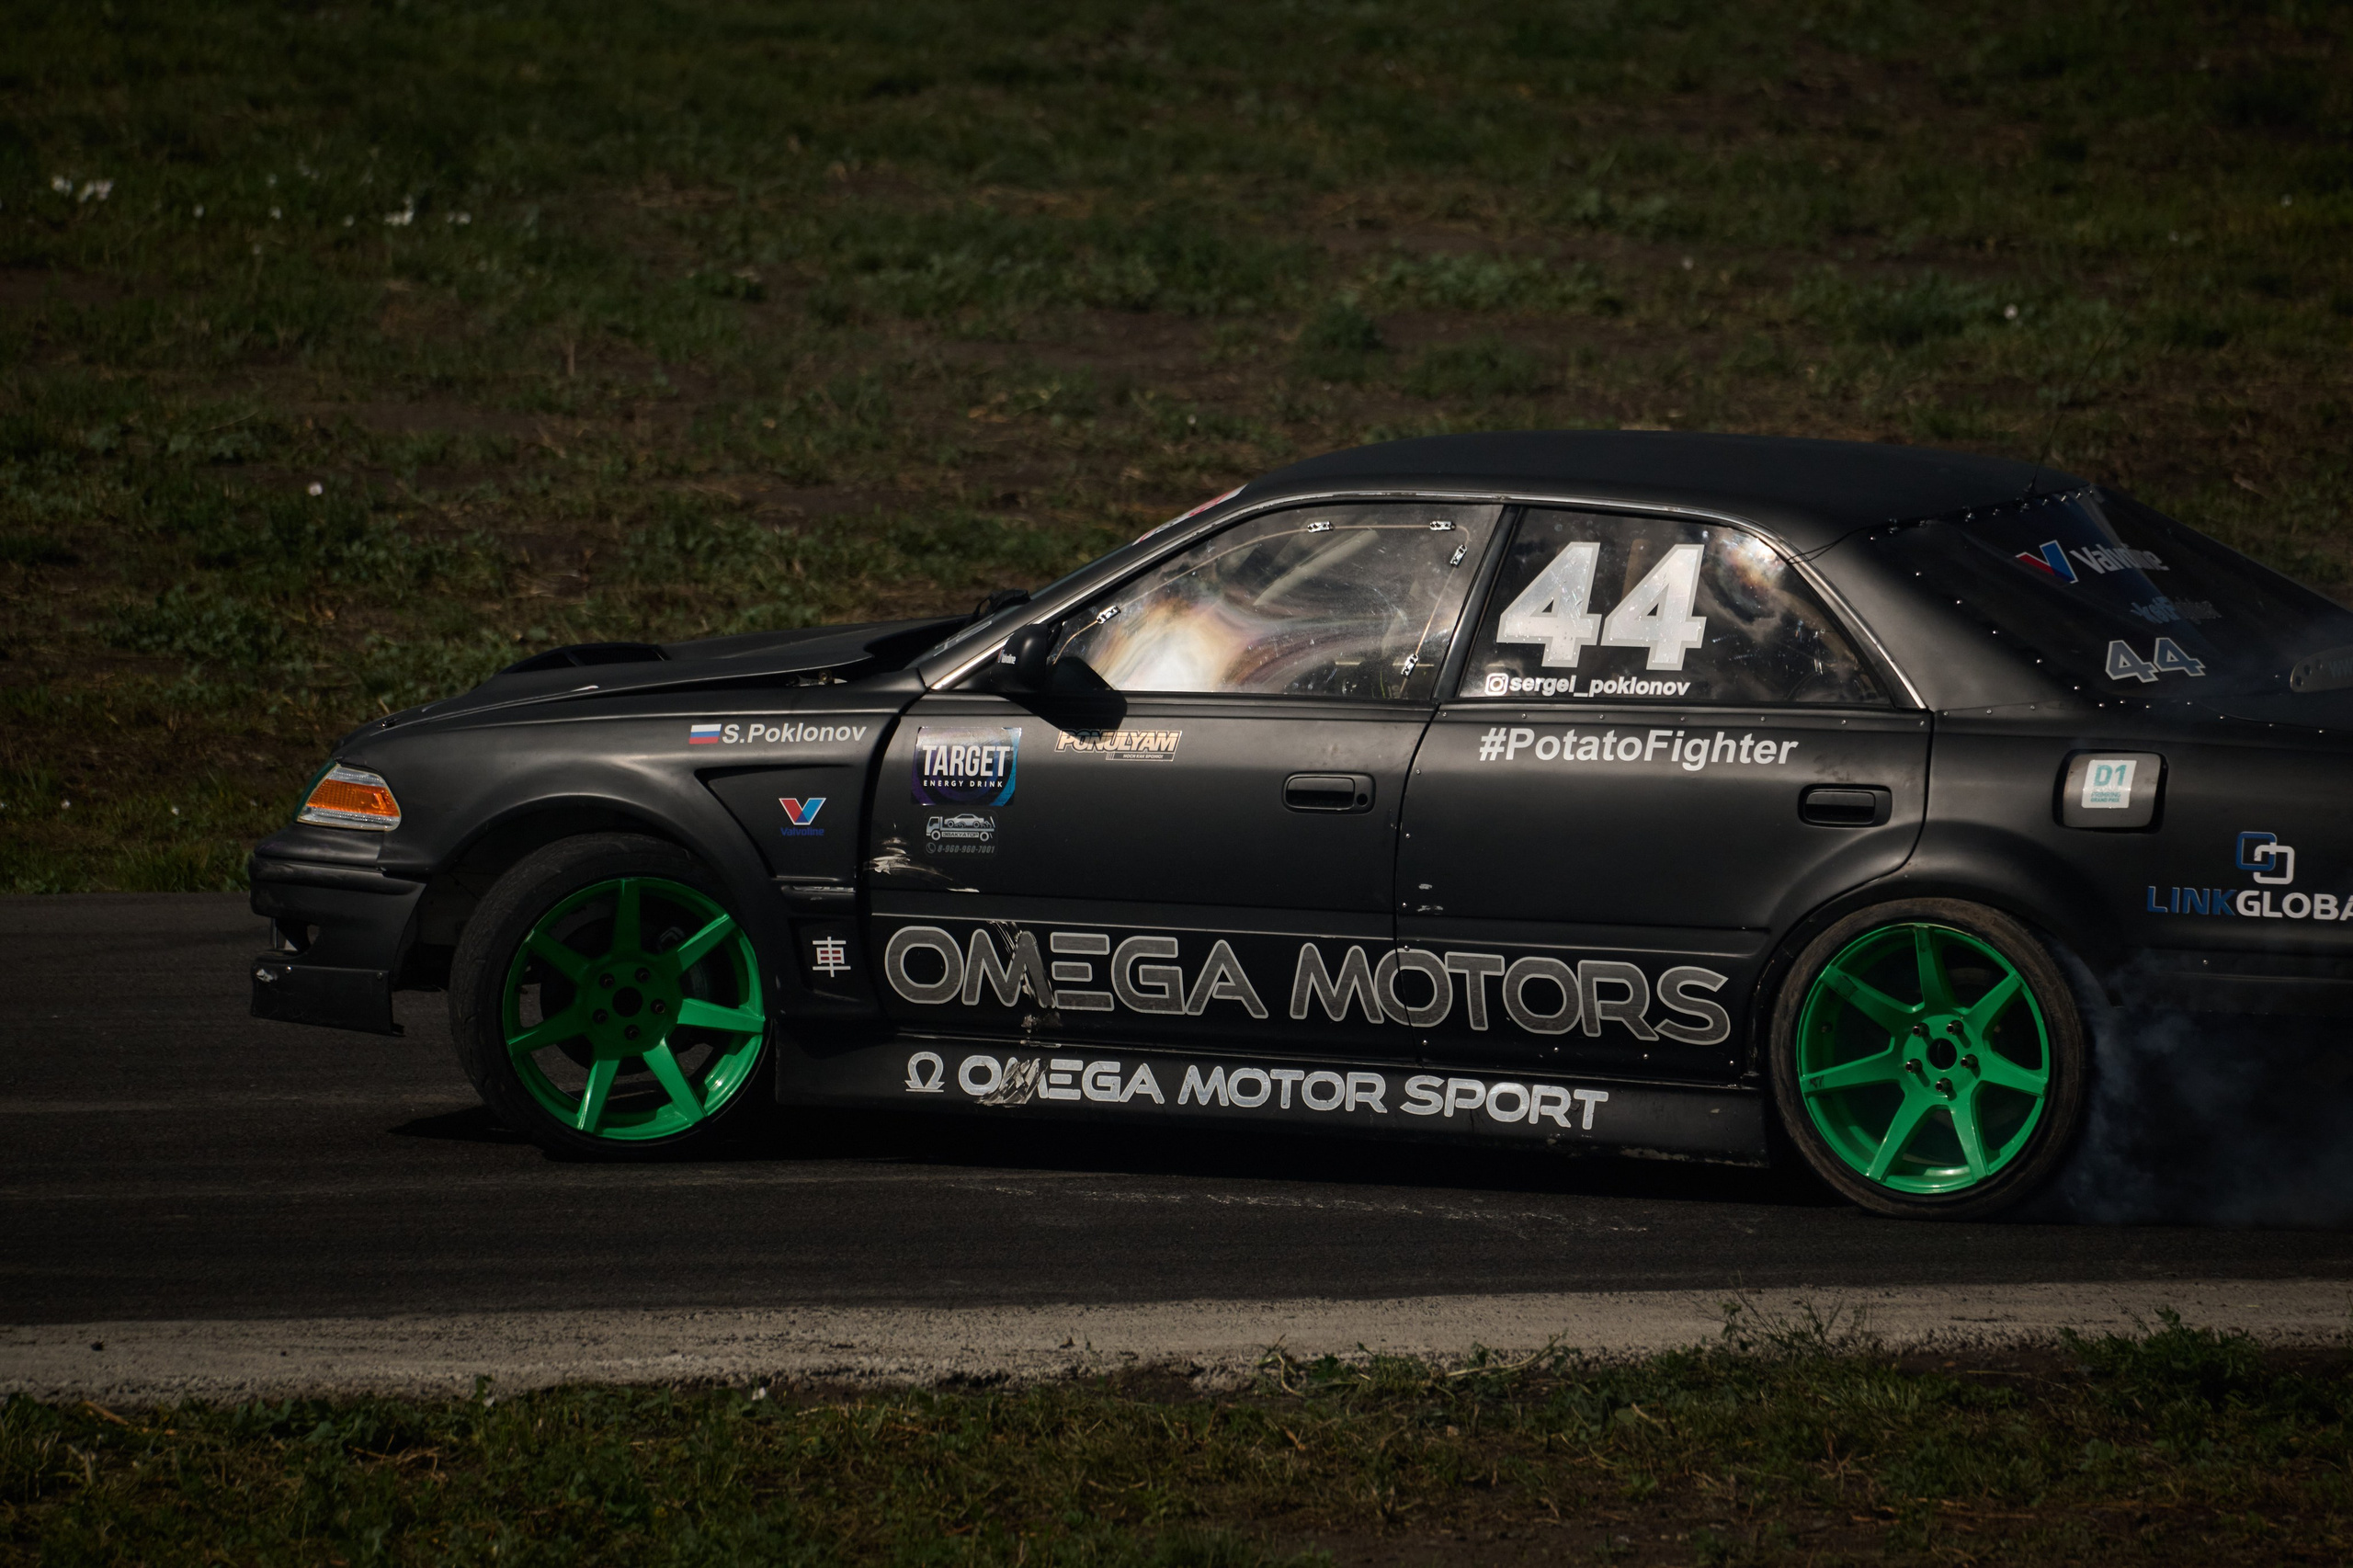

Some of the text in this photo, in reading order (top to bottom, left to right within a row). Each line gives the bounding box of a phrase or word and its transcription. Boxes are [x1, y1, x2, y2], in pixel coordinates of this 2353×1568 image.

[1496, 541, 1707, 671] 44
[2105, 637, 2206, 683] 44
[722, 722, 867, 744] S.Poklonov
[1055, 729, 1181, 753] PONULYAM
[1479, 727, 1799, 771] #PotatoFighter
[923, 745, 1010, 778] TARGET
[2094, 764, 2127, 786] D1
[923, 779, 964, 788] ENERGY
[780, 827, 824, 836] Valvoline
[884, 926, 1730, 1045] OMEGA MOTORS
[959, 1055, 1165, 1105] OMEGA
[1177, 1065, 1388, 1114] MOTOR
[1400, 1074, 1608, 1131] SPORT
